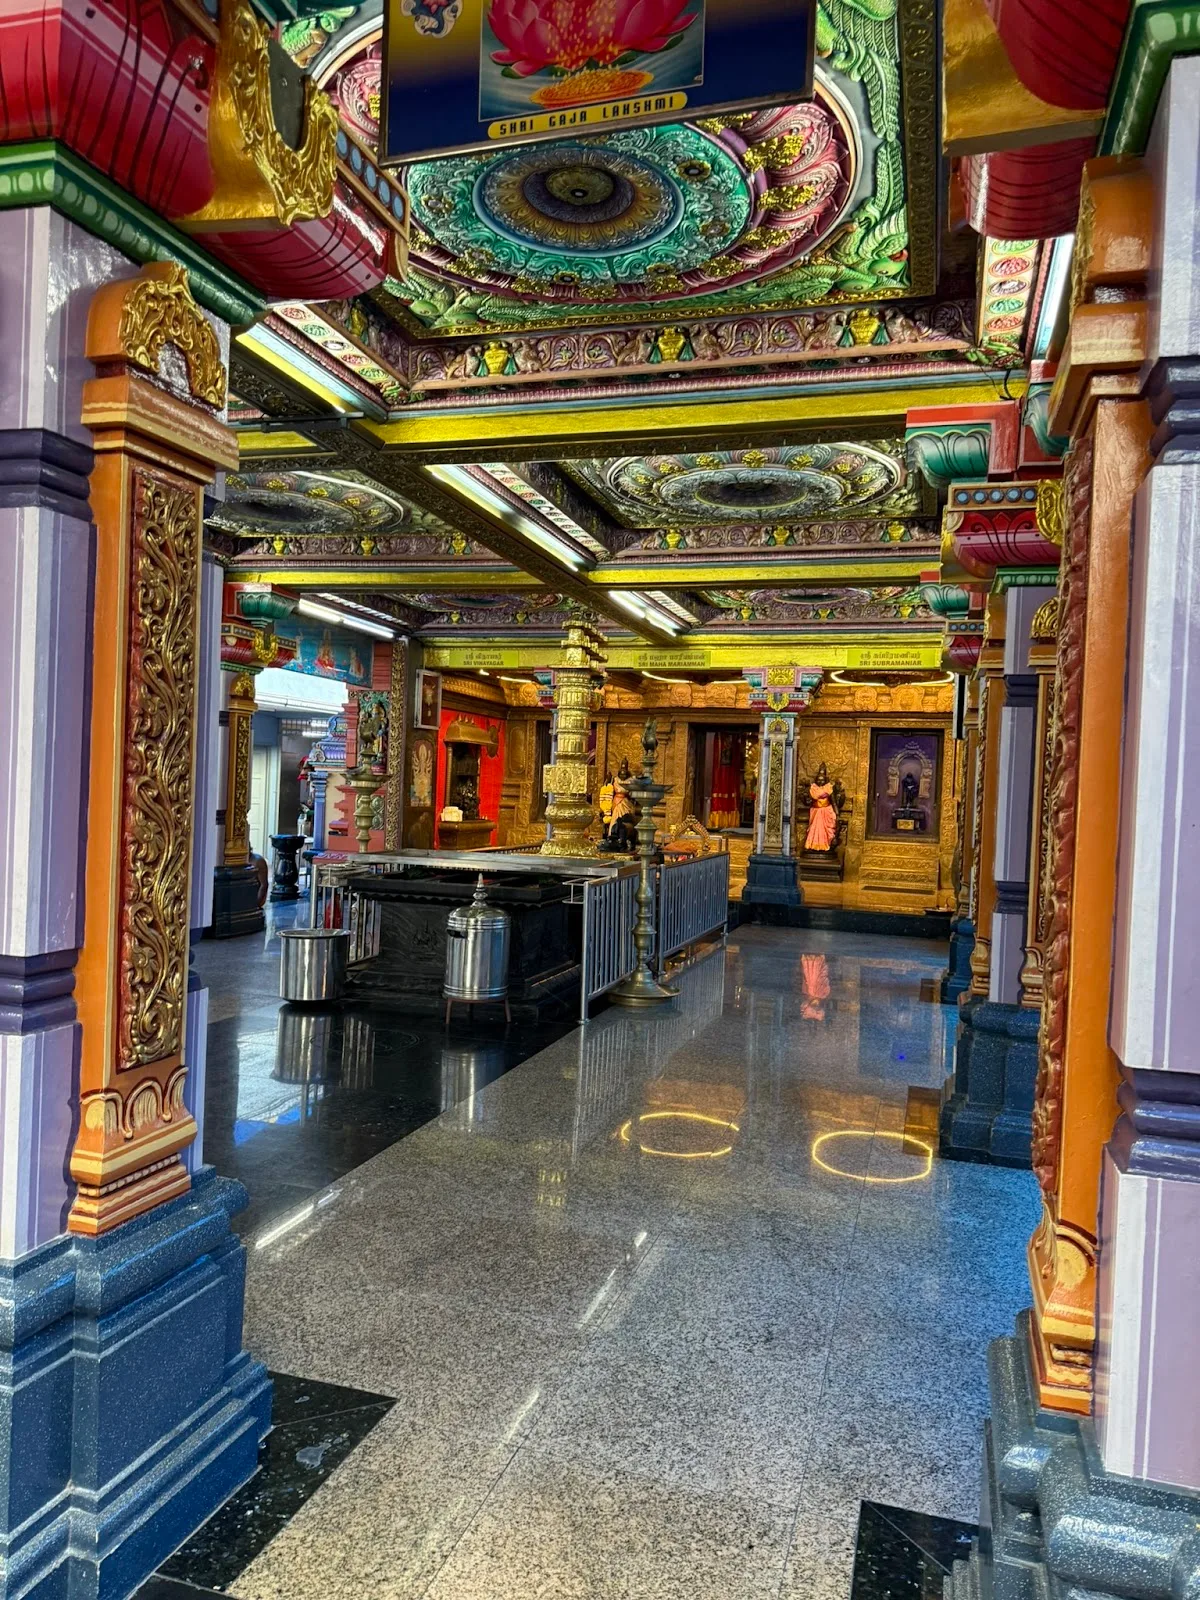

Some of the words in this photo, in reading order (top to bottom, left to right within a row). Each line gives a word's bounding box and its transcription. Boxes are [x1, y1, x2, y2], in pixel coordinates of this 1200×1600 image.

[500, 120, 534, 135] SHRI
[549, 111, 587, 127] GAJA
[603, 96, 673, 118] LAKSHMI
